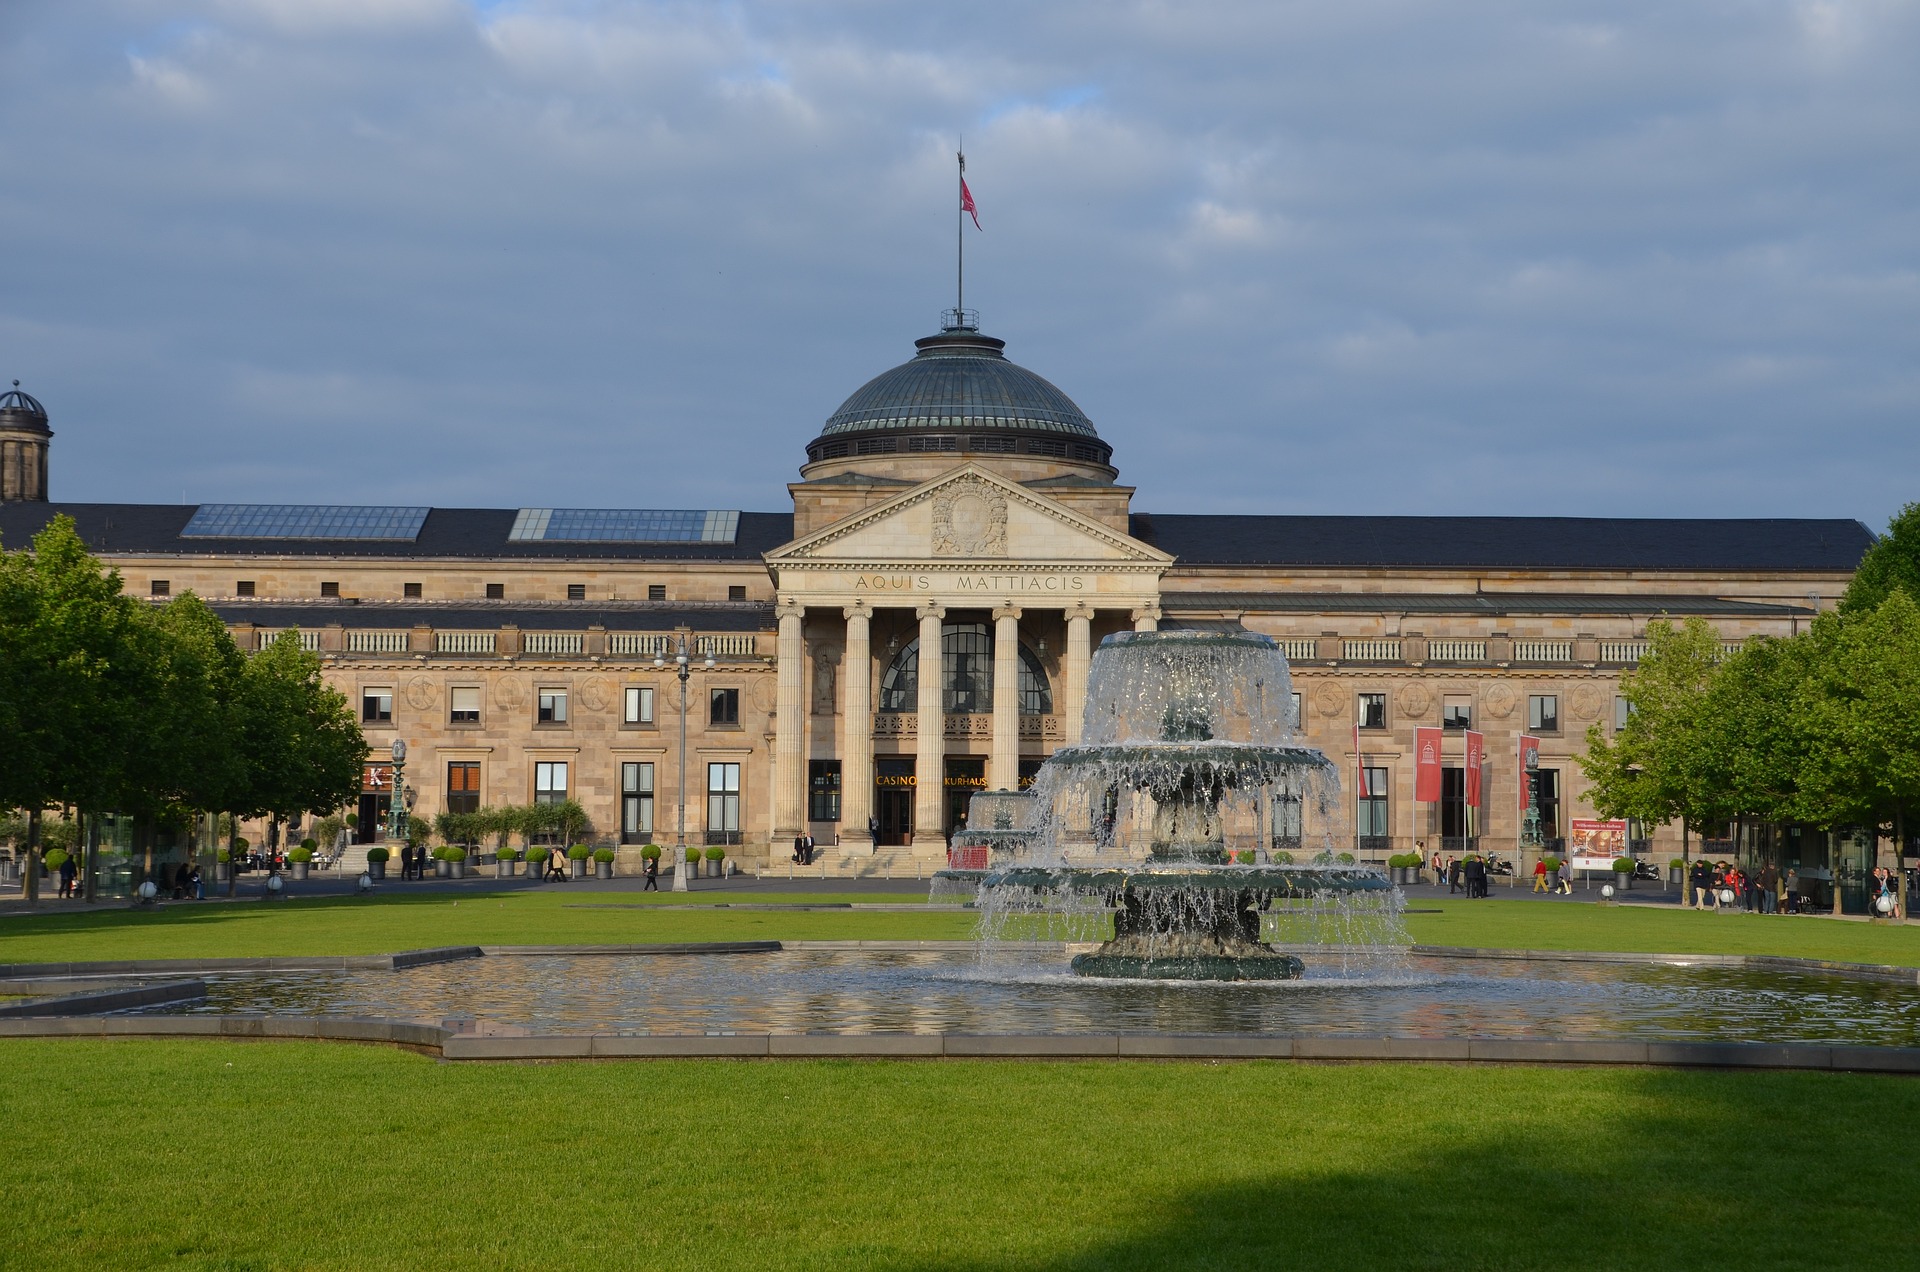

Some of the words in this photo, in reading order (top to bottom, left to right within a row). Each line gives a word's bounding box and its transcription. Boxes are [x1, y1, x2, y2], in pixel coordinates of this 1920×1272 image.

[855, 575, 930, 589] AQUIS
[956, 575, 1083, 590] MATTIACIS
[370, 768, 383, 785] K
[876, 775, 918, 786] CASINO
[944, 777, 988, 786] KURHAUS
